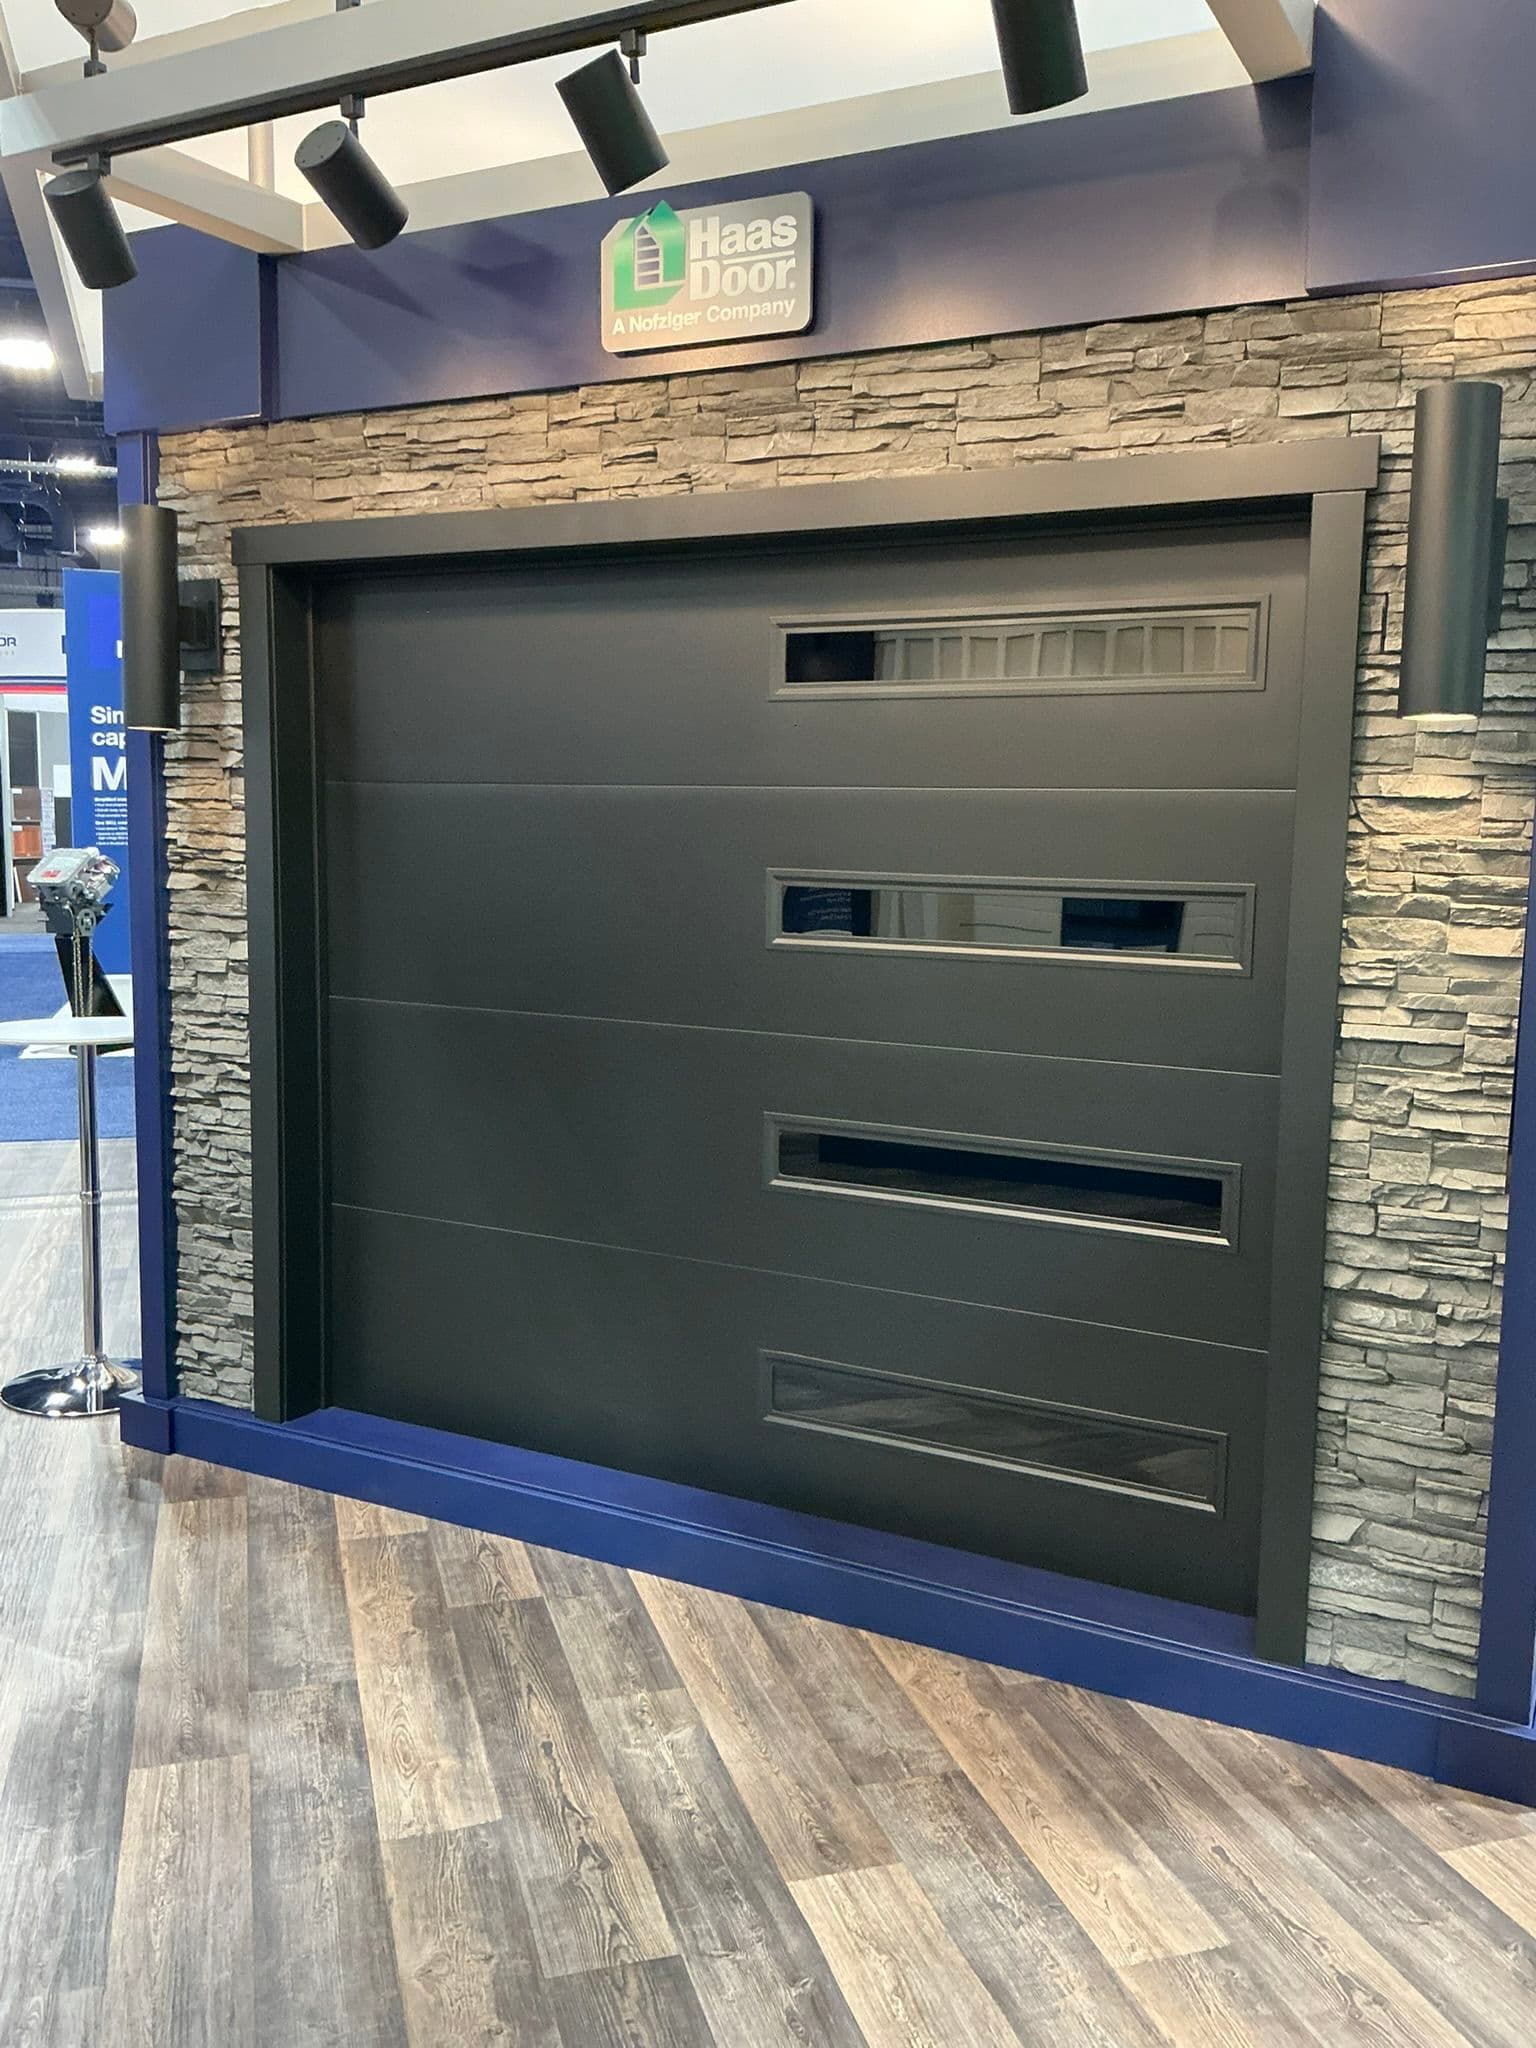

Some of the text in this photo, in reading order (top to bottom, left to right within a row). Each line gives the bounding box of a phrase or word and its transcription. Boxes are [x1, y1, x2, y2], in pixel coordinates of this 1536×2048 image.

[689, 215, 797, 259] Haas
[612, 299, 795, 335] A Nofziger Company
[93, 757, 127, 790] M
